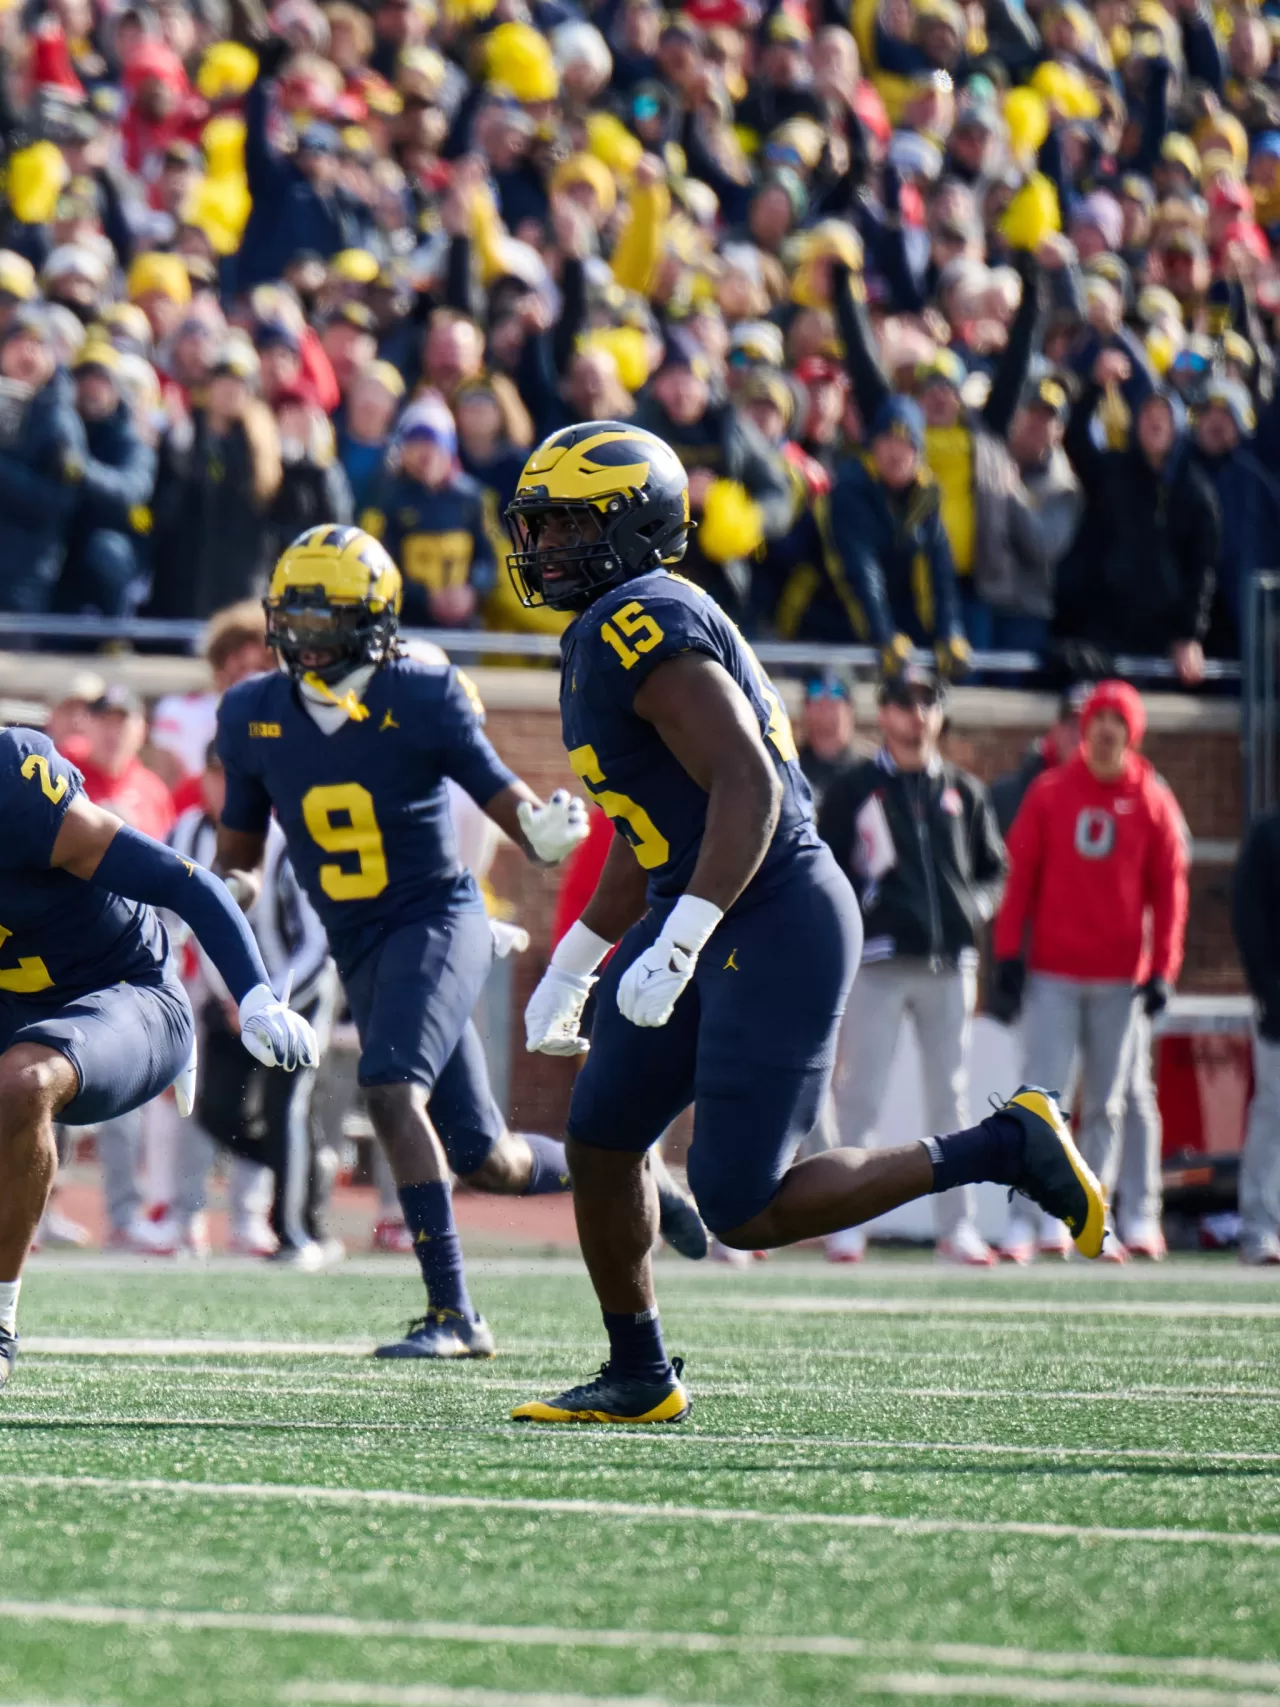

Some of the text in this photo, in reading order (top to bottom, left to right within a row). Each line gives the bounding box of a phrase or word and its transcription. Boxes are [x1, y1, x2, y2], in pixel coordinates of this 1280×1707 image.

[601, 601, 664, 670] 15
[21, 754, 68, 805] 2
[302, 782, 389, 901] 9
